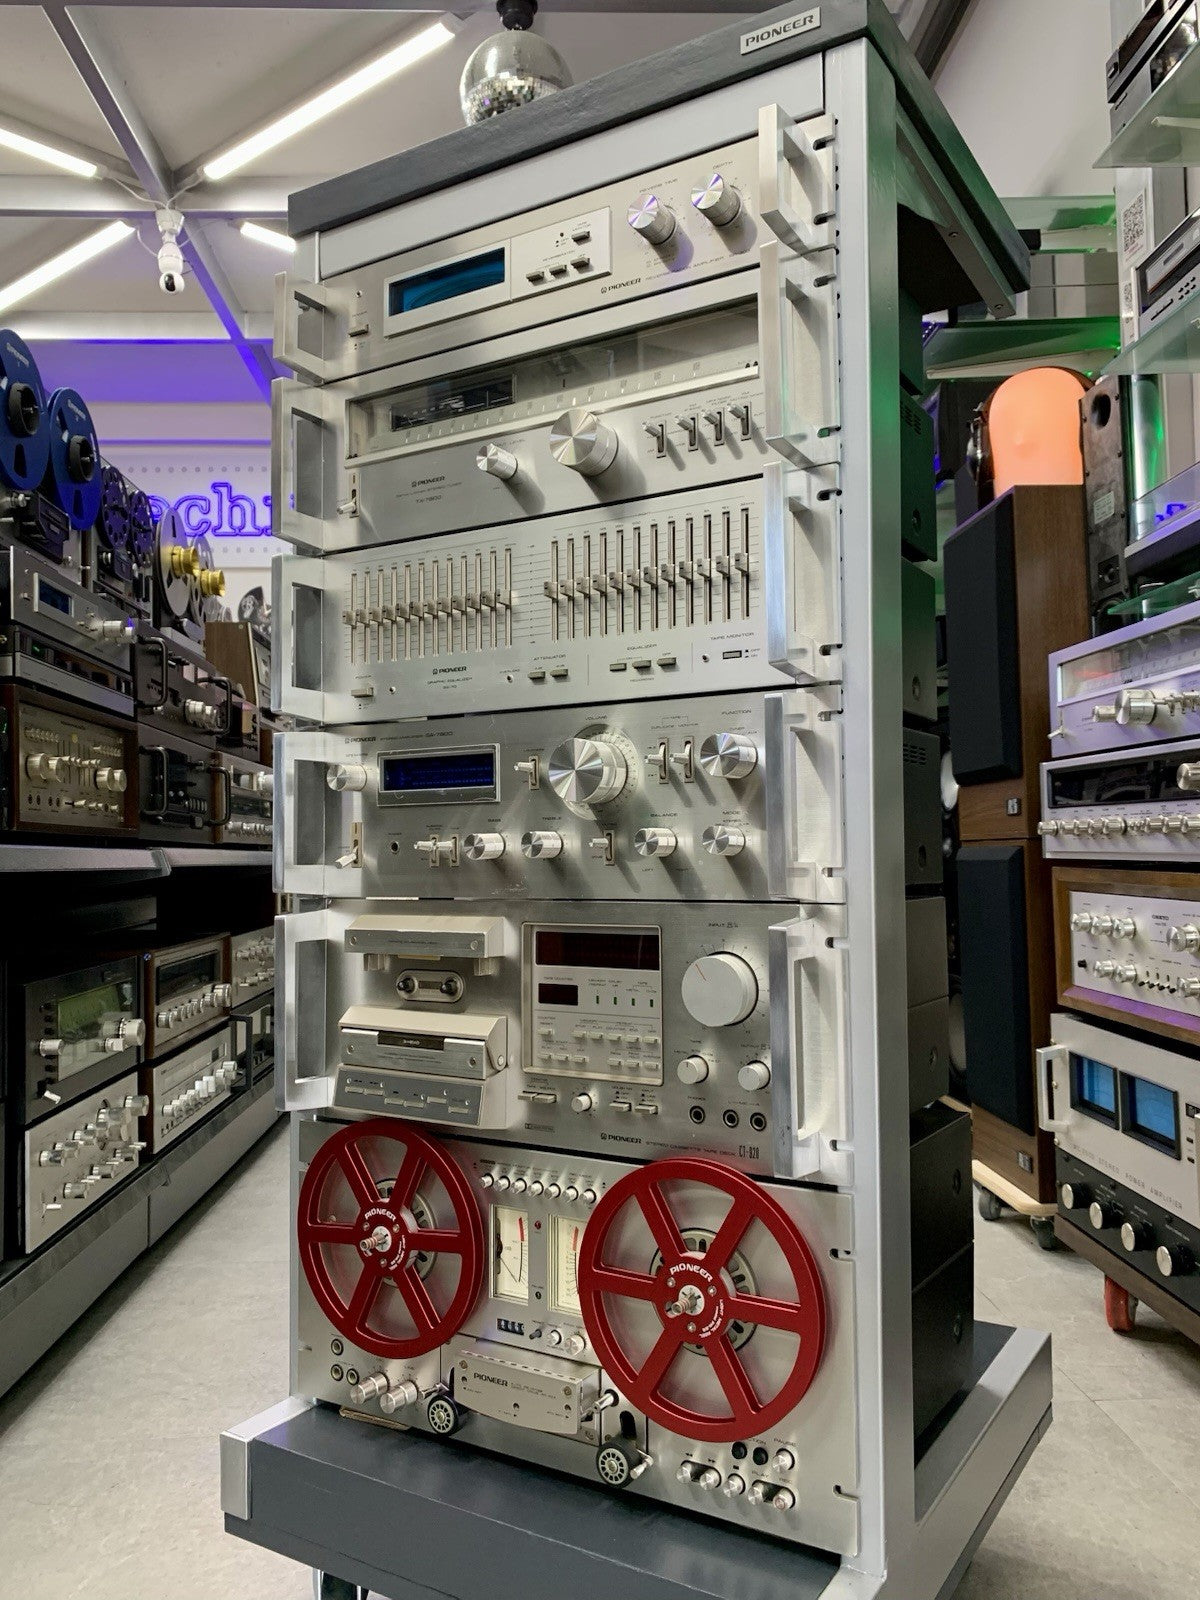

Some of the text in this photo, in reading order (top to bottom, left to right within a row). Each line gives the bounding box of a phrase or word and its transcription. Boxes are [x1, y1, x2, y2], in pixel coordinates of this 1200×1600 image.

[746, 14, 814, 46] PIONEER
[608, 278, 641, 291] PIONEER
[417, 475, 445, 486] PIONEER
[726, 632, 754, 640] MONITOR
[438, 665, 467, 674] PIONEER
[608, 1134, 642, 1144] PIONEER
[364, 1208, 397, 1222] PIONEER
[669, 1262, 713, 1283] PIONEER
[473, 1372, 508, 1386] PIONEER
